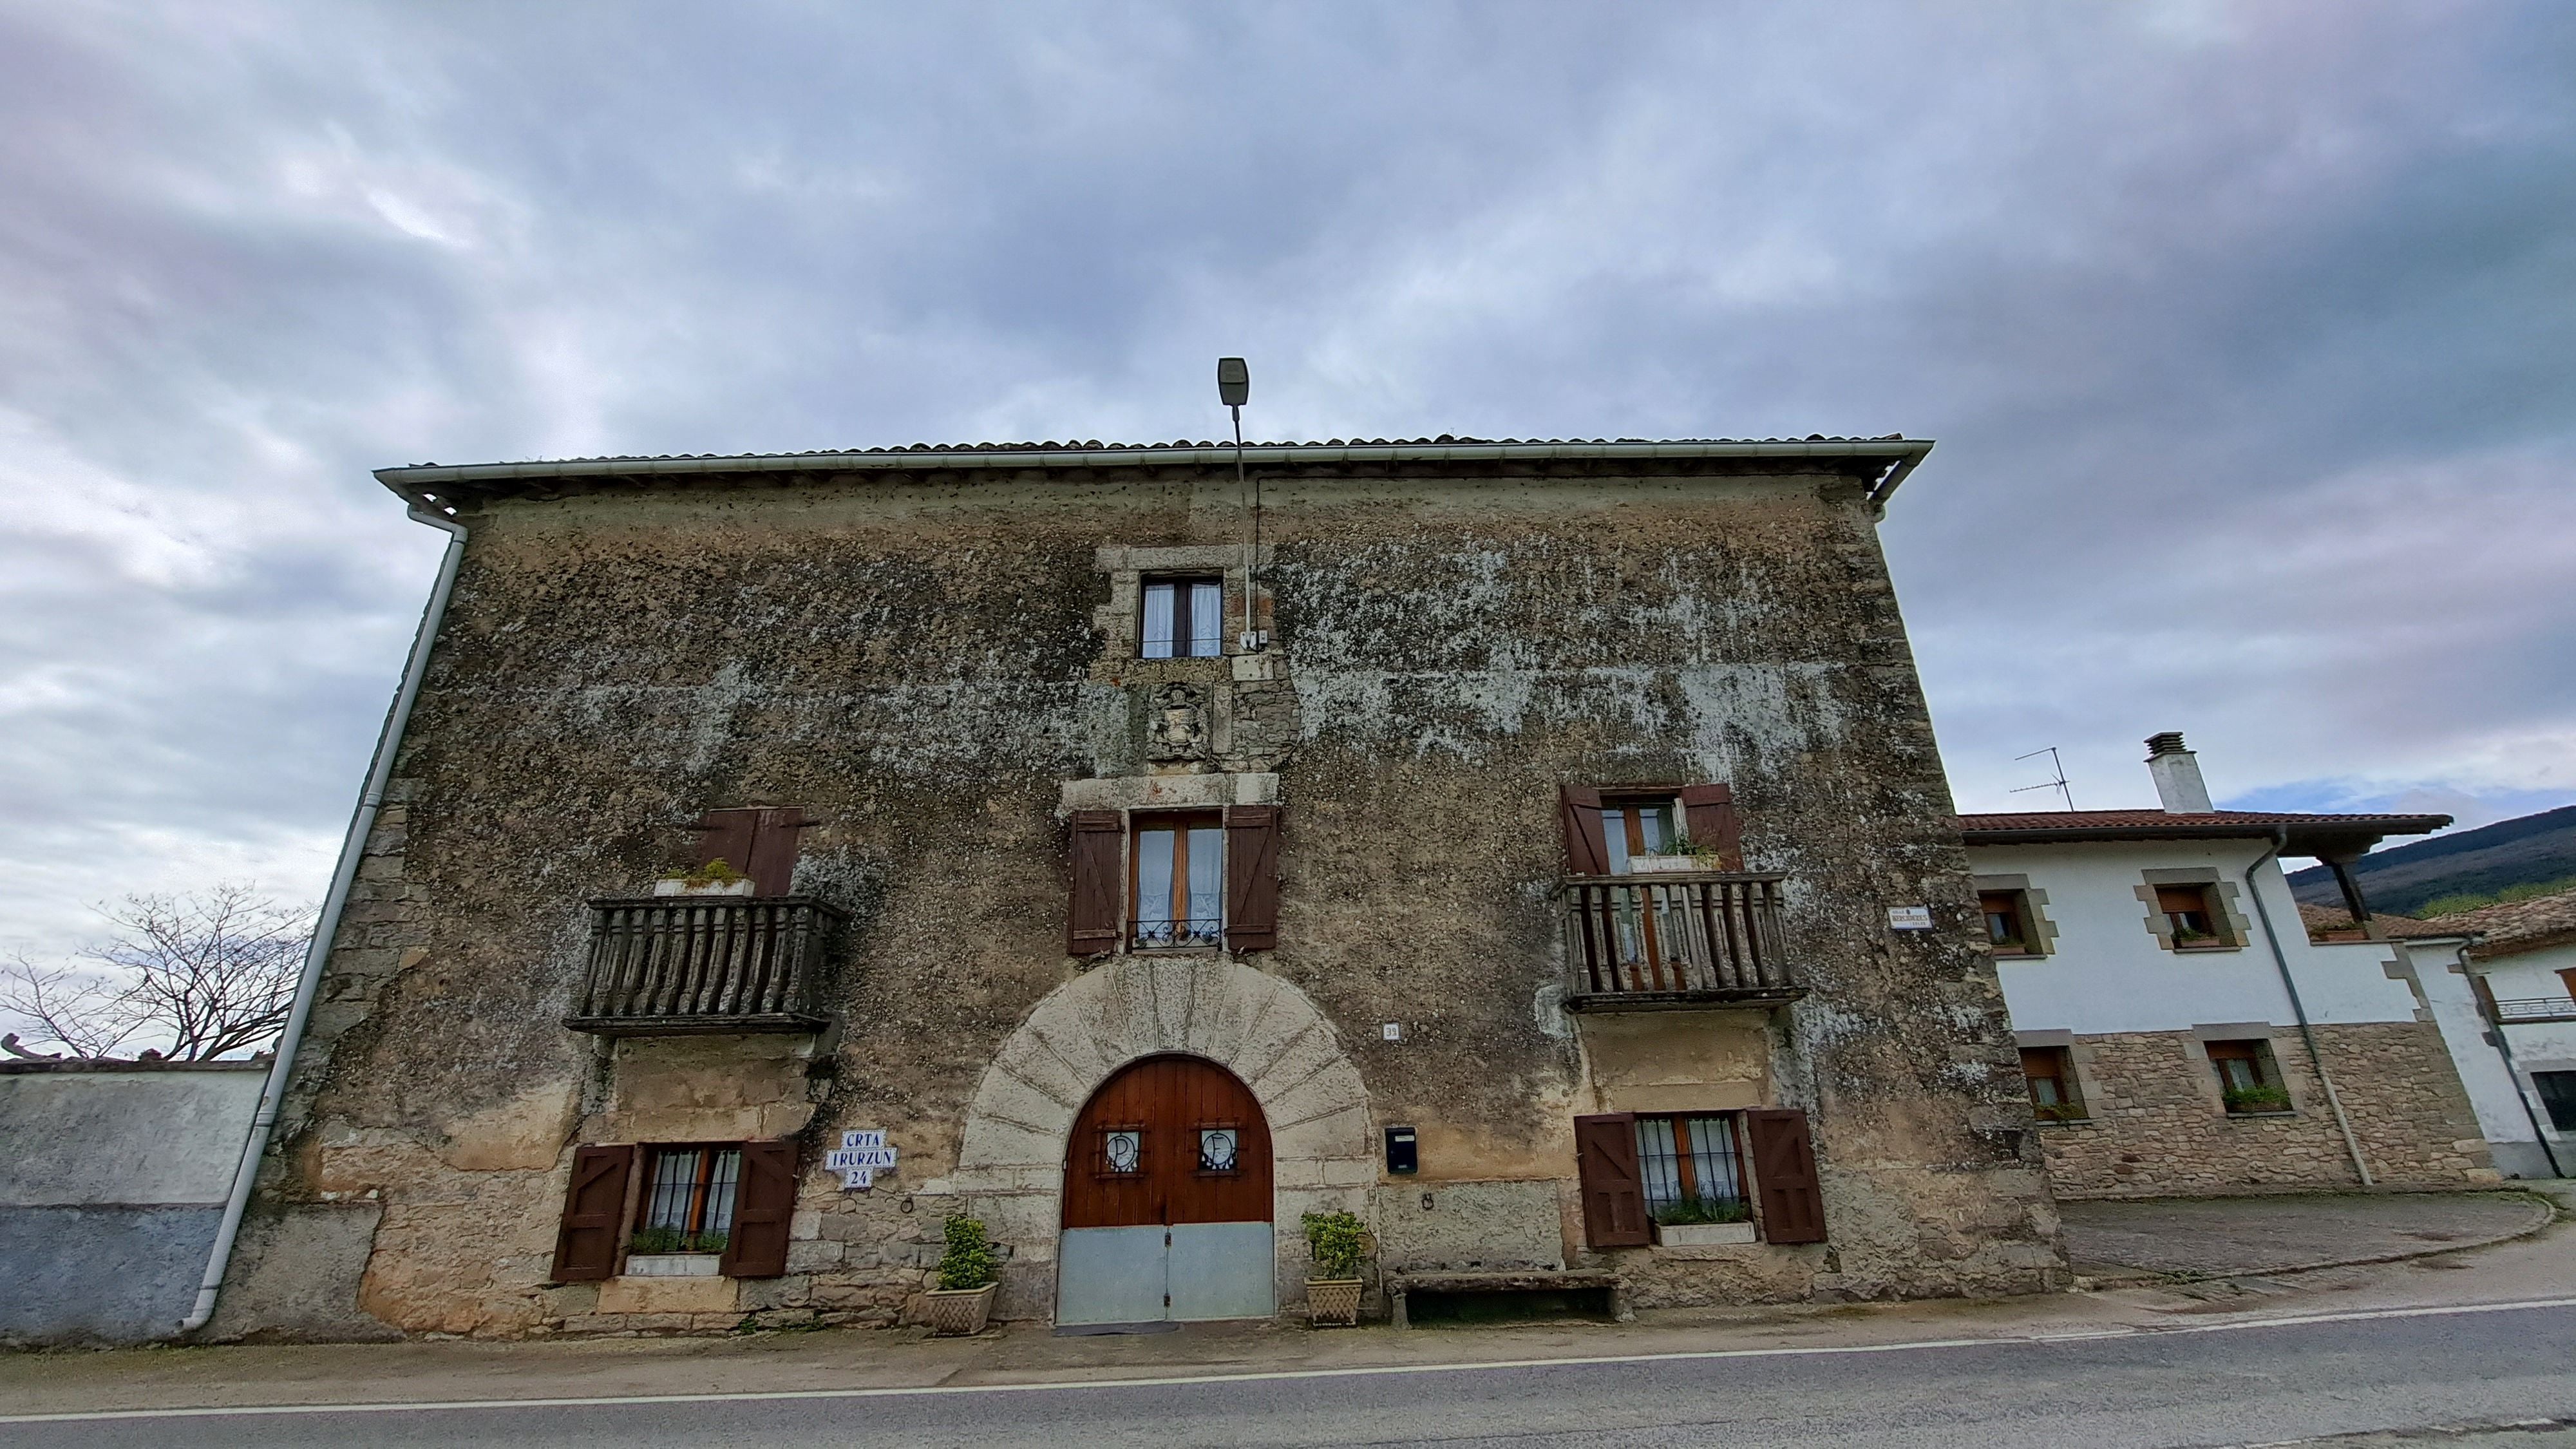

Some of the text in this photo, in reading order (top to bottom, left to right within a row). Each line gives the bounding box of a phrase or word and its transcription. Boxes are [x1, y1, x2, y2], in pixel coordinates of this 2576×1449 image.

[847, 1133, 879, 1146] CRTA
[833, 1151, 892, 1166] IRURZUN
[851, 1171, 867, 1184] 24
